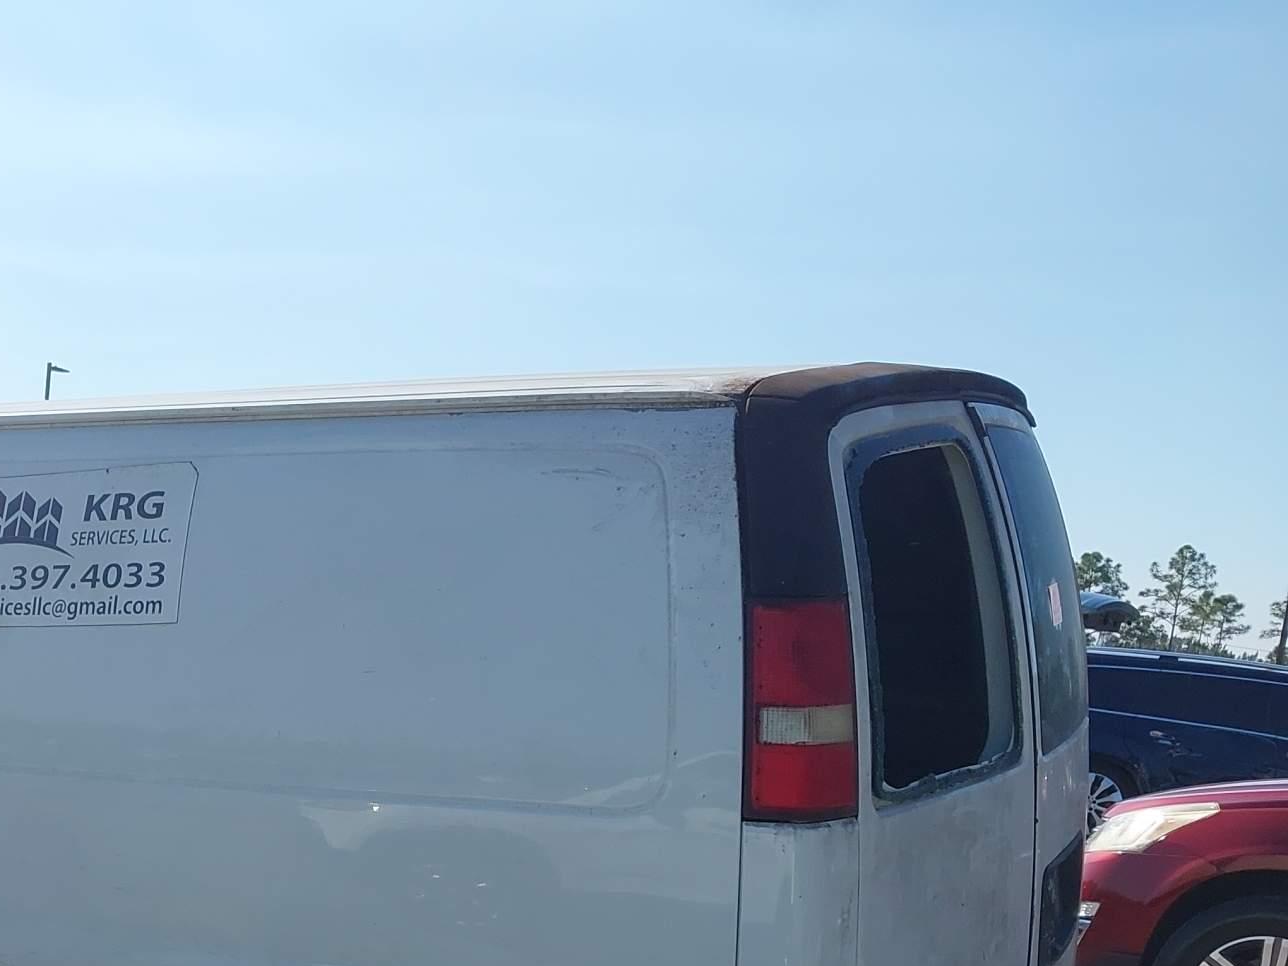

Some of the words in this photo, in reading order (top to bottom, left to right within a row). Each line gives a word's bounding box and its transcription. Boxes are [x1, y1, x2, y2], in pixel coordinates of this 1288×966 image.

[83, 491, 166, 522] KRG
[70, 529, 139, 547] SERVICES,
[142, 528, 172, 545] LLC.
